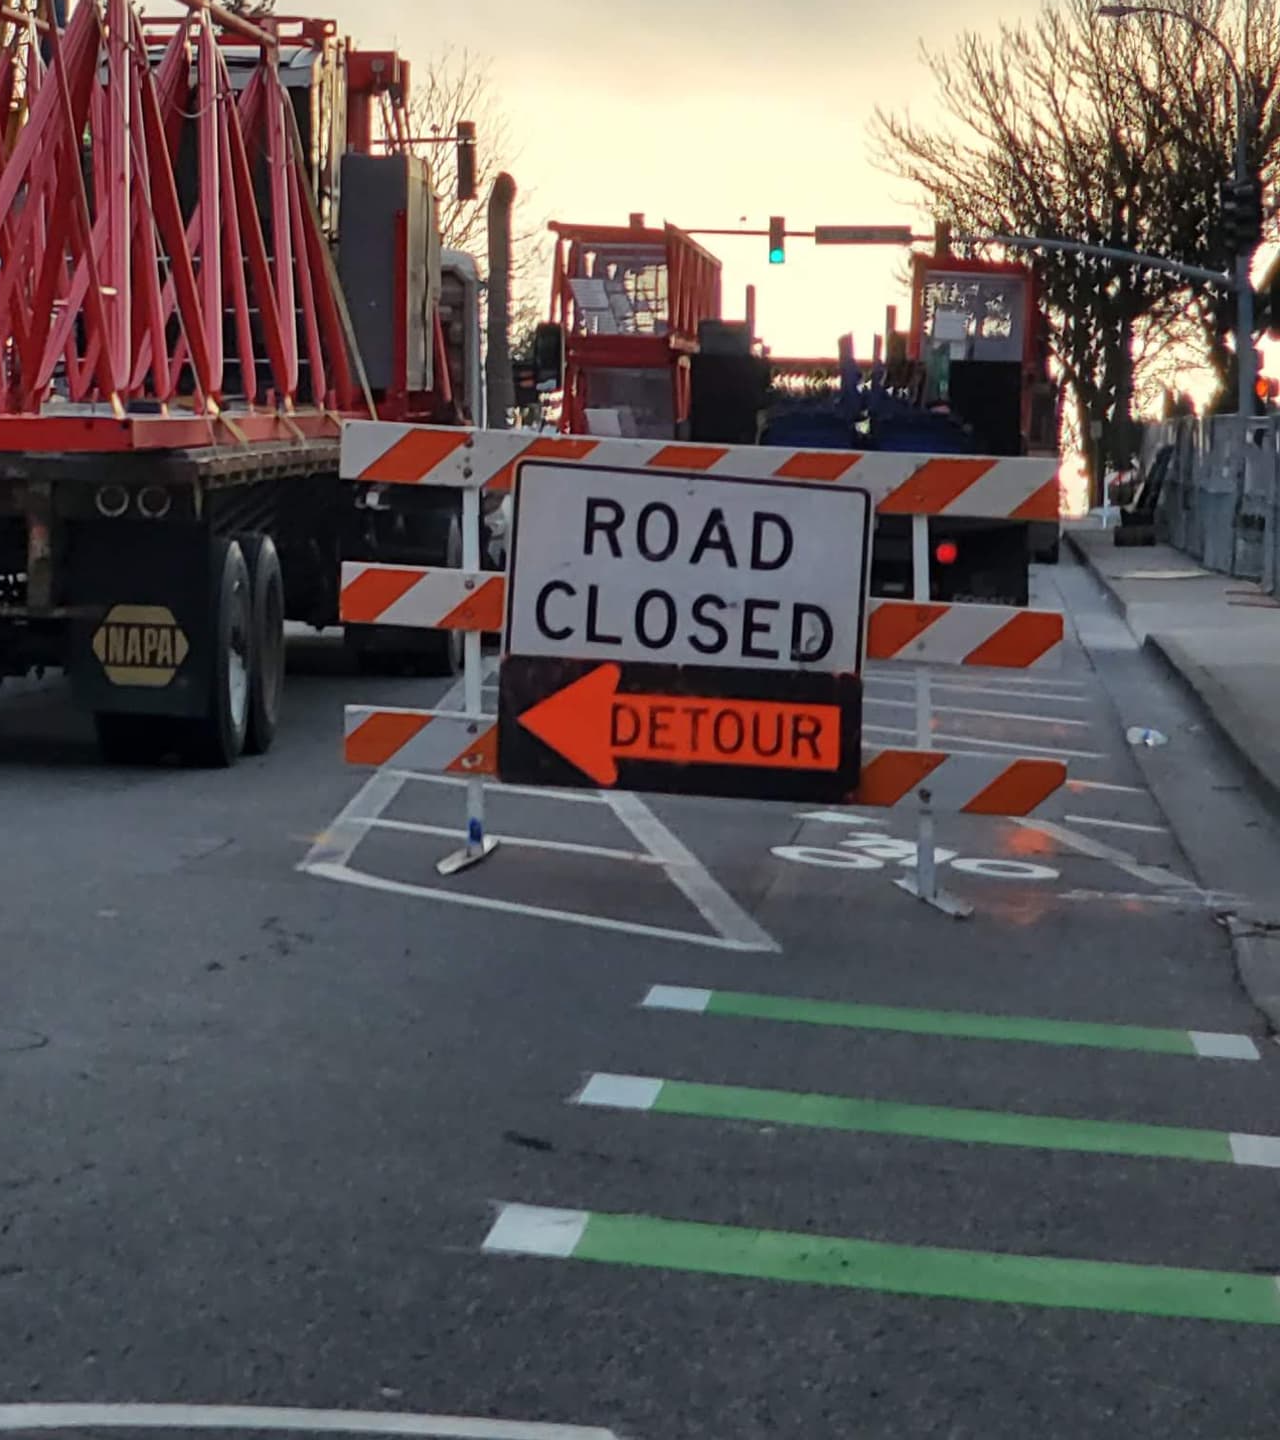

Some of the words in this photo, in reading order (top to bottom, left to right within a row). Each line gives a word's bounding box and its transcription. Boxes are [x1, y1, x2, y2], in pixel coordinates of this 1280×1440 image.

[583, 498, 794, 571] ROAD
[108, 625, 173, 666] NAPA
[535, 580, 834, 664] CLOSED
[610, 703, 823, 760] DETOUR
